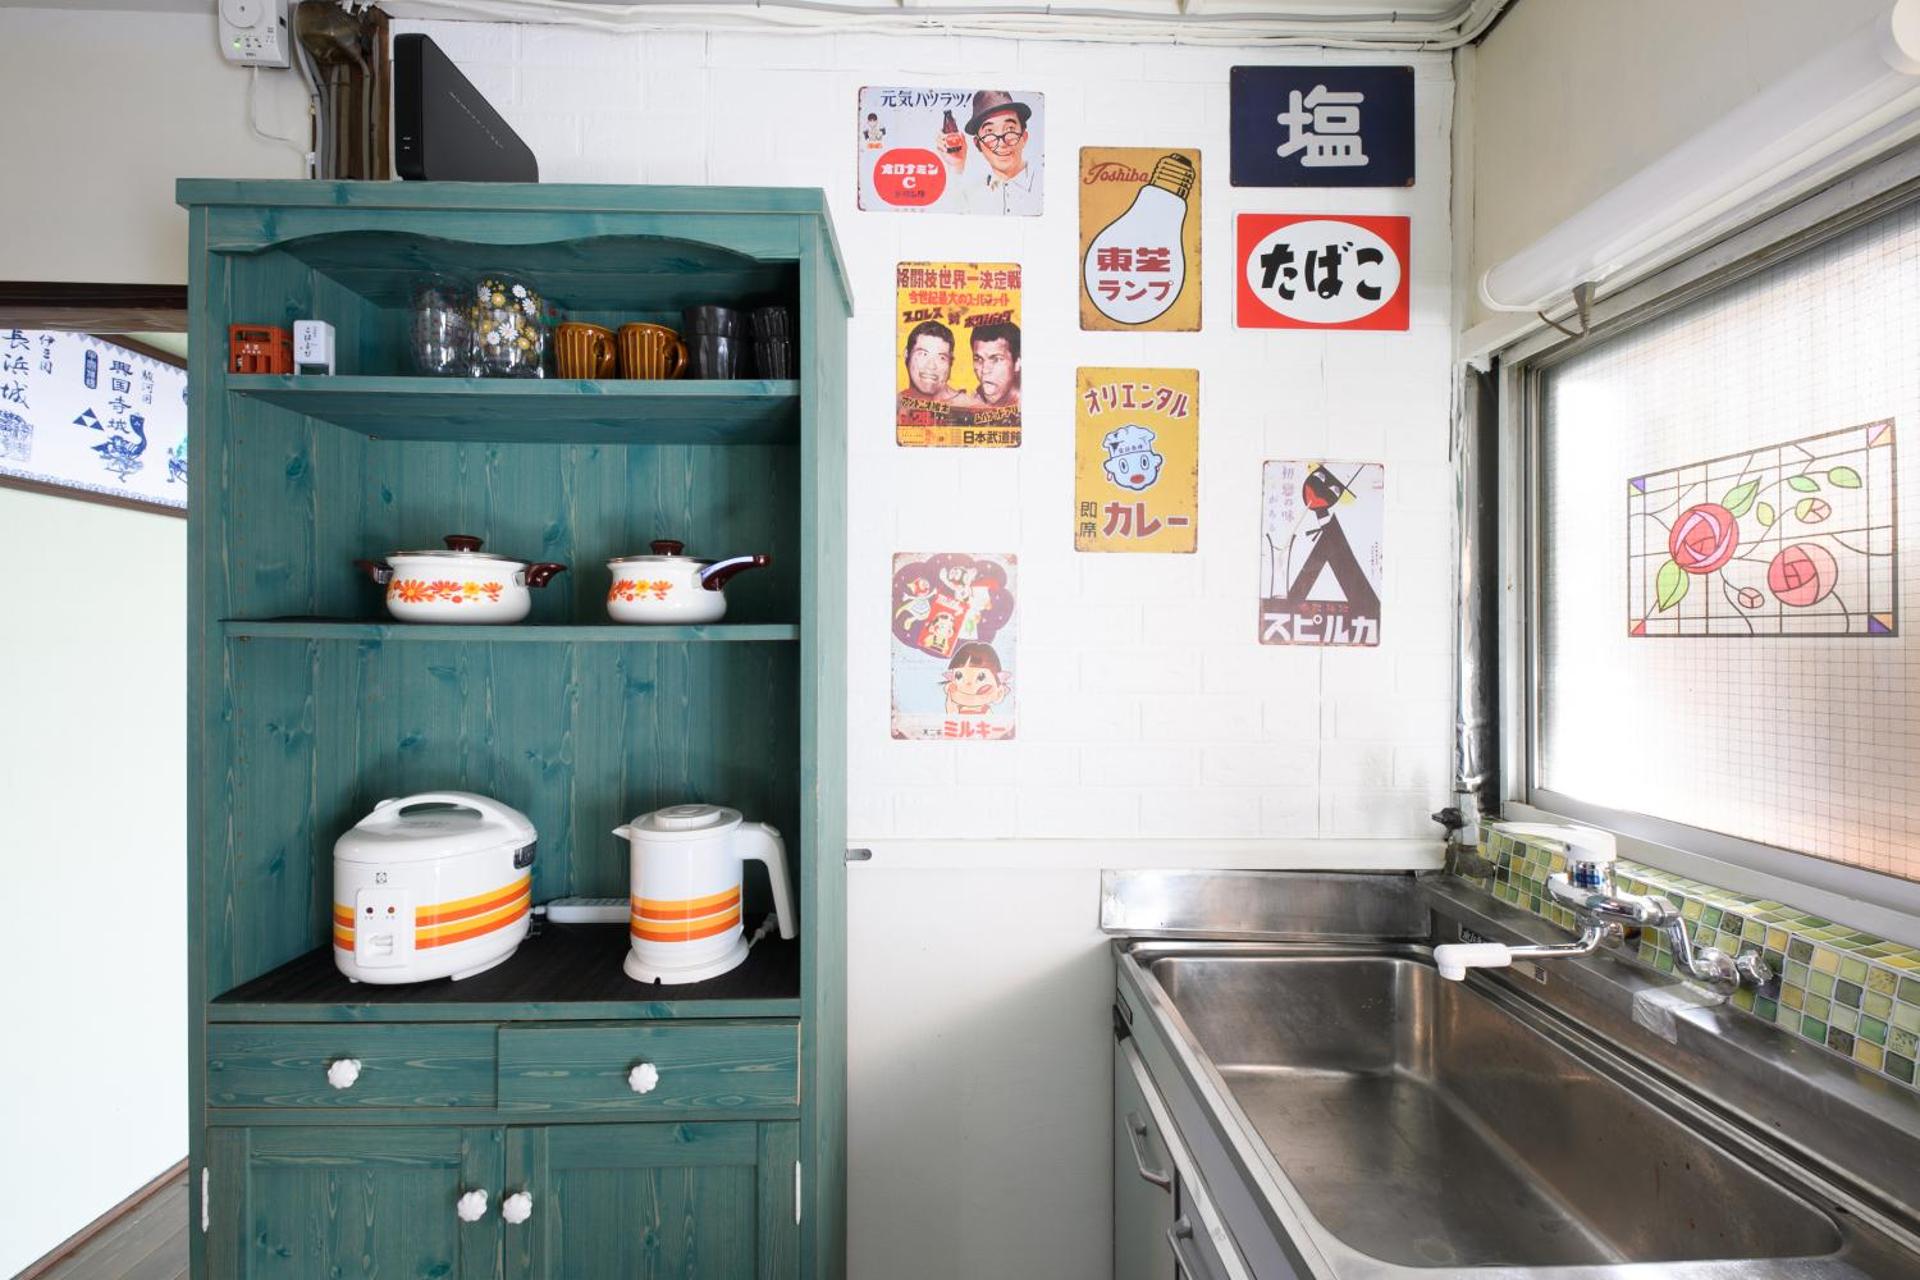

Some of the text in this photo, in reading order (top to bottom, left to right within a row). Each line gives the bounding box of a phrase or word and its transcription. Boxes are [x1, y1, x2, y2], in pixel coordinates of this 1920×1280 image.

[1277, 84, 1369, 167] 塩
[881, 163, 938, 175] オロナミン
[1084, 162, 1151, 185] Toshiba
[902, 177, 916, 189] C
[1097, 247, 1171, 272] 東芝
[1260, 241, 1385, 301] たばこ
[1098, 280, 1175, 301] ランプ
[1085, 384, 1188, 418] オリエンタル
[1080, 501, 1098, 539] 即席
[1103, 501, 1189, 538] カレー
[944, 721, 1006, 738] ミルキー
